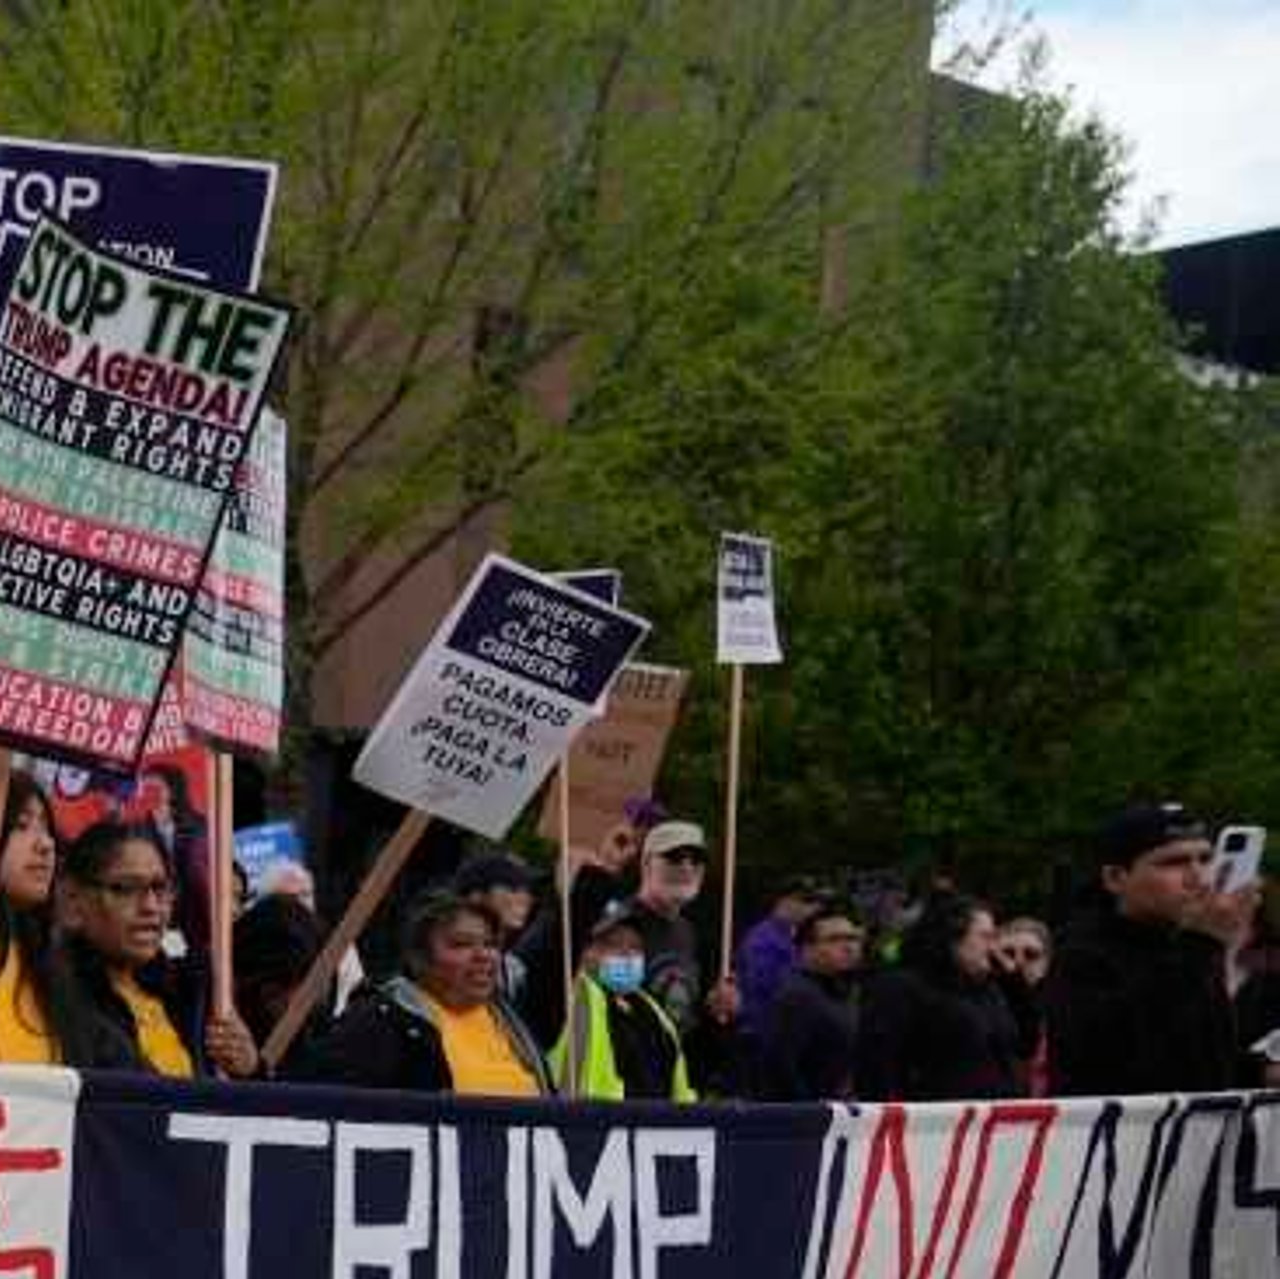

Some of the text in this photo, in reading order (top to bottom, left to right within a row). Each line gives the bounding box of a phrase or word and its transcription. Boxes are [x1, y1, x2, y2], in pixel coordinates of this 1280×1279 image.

[16, 229, 278, 381] STOP THE
[7, 300, 249, 427] TRUMP AGENDA!
[68, 389, 87, 416] &
[106, 400, 242, 460] EXPAND
[111, 433, 234, 489] RIGHTS
[89, 529, 202, 581] CRIMES
[76, 597, 178, 643] RIGHTS
[125, 579, 188, 615] AND
[500, 620, 581, 664] CLASE
[440, 662, 573, 727] PAGAMOS
[493, 747, 527, 771] LA
